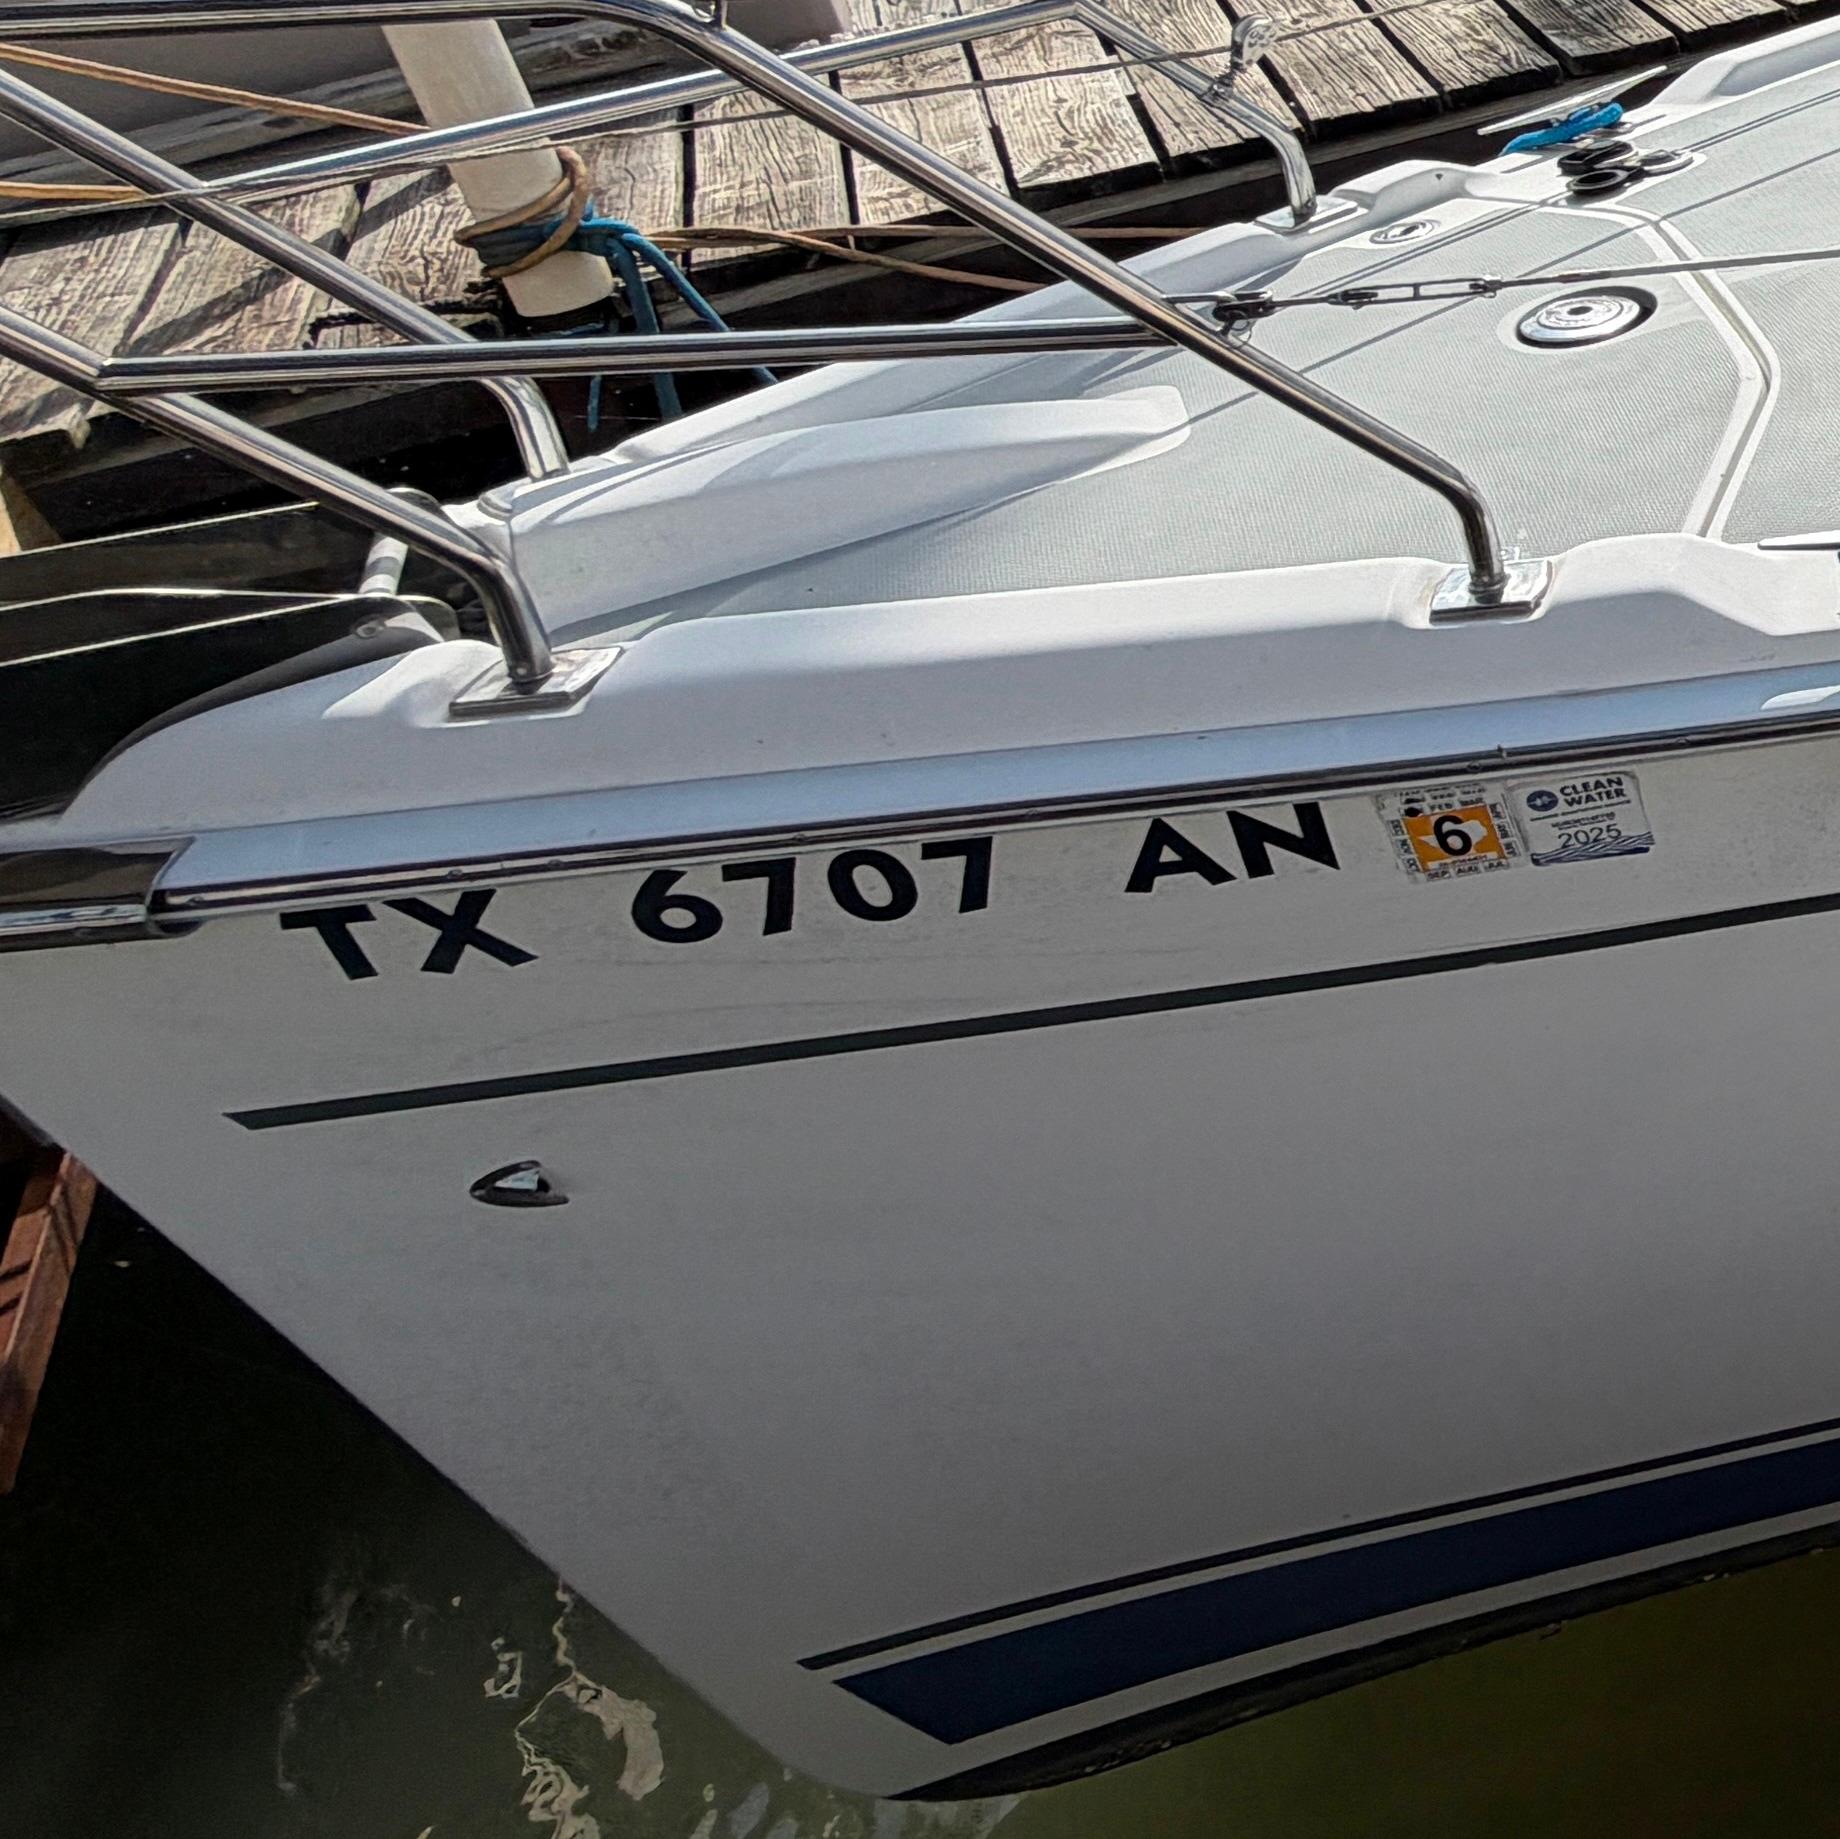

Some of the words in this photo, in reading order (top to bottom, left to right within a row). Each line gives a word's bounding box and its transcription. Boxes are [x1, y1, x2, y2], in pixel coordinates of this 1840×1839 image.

[1559, 776, 1624, 797] CLEAN
[1563, 788, 1626, 808] WATER
[1433, 815, 1473, 857] 6
[1557, 823, 1622, 850] 2025
[277, 888, 539, 981] TX
[630, 835, 994, 944] 6707
[1125, 802, 1340, 894] AN
